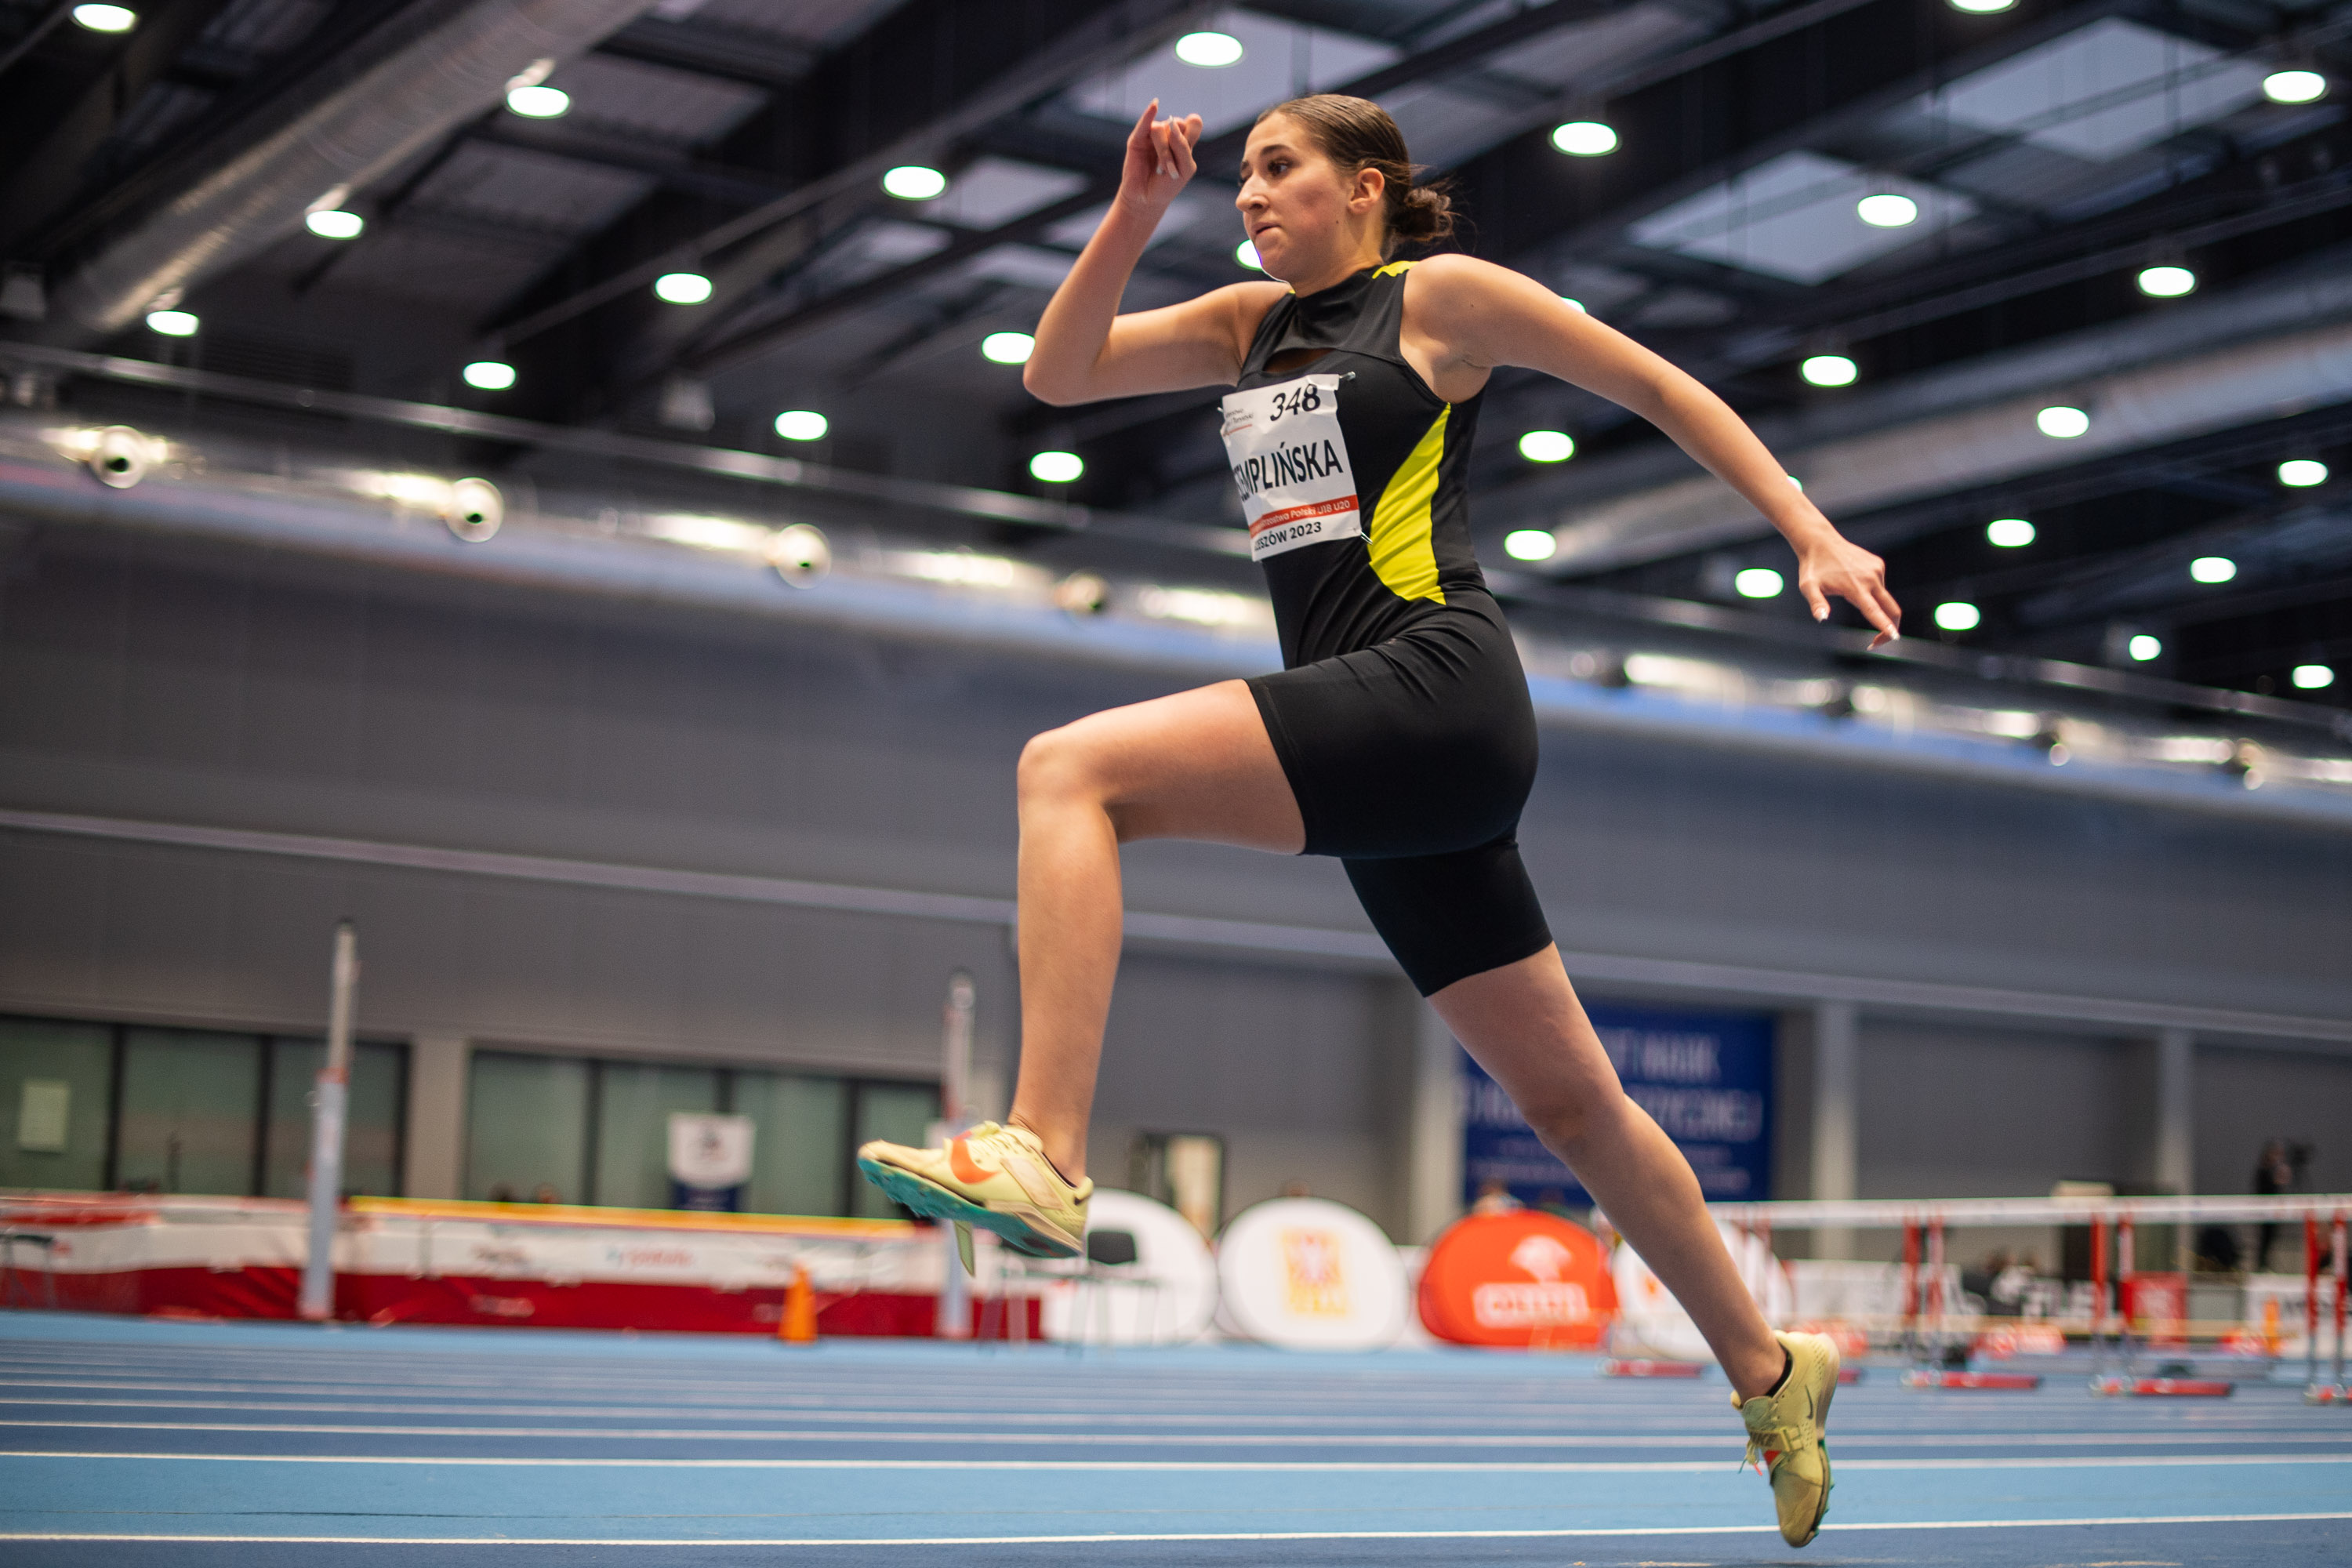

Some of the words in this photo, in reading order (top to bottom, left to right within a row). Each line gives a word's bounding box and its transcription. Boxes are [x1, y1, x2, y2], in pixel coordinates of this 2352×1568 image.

[1269, 383, 1321, 422] 348
[1290, 506, 1316, 518] Polski
[1317, 504, 1332, 514] U18
[1333, 499, 1350, 511] U20
[1290, 521, 1322, 539] 2023
